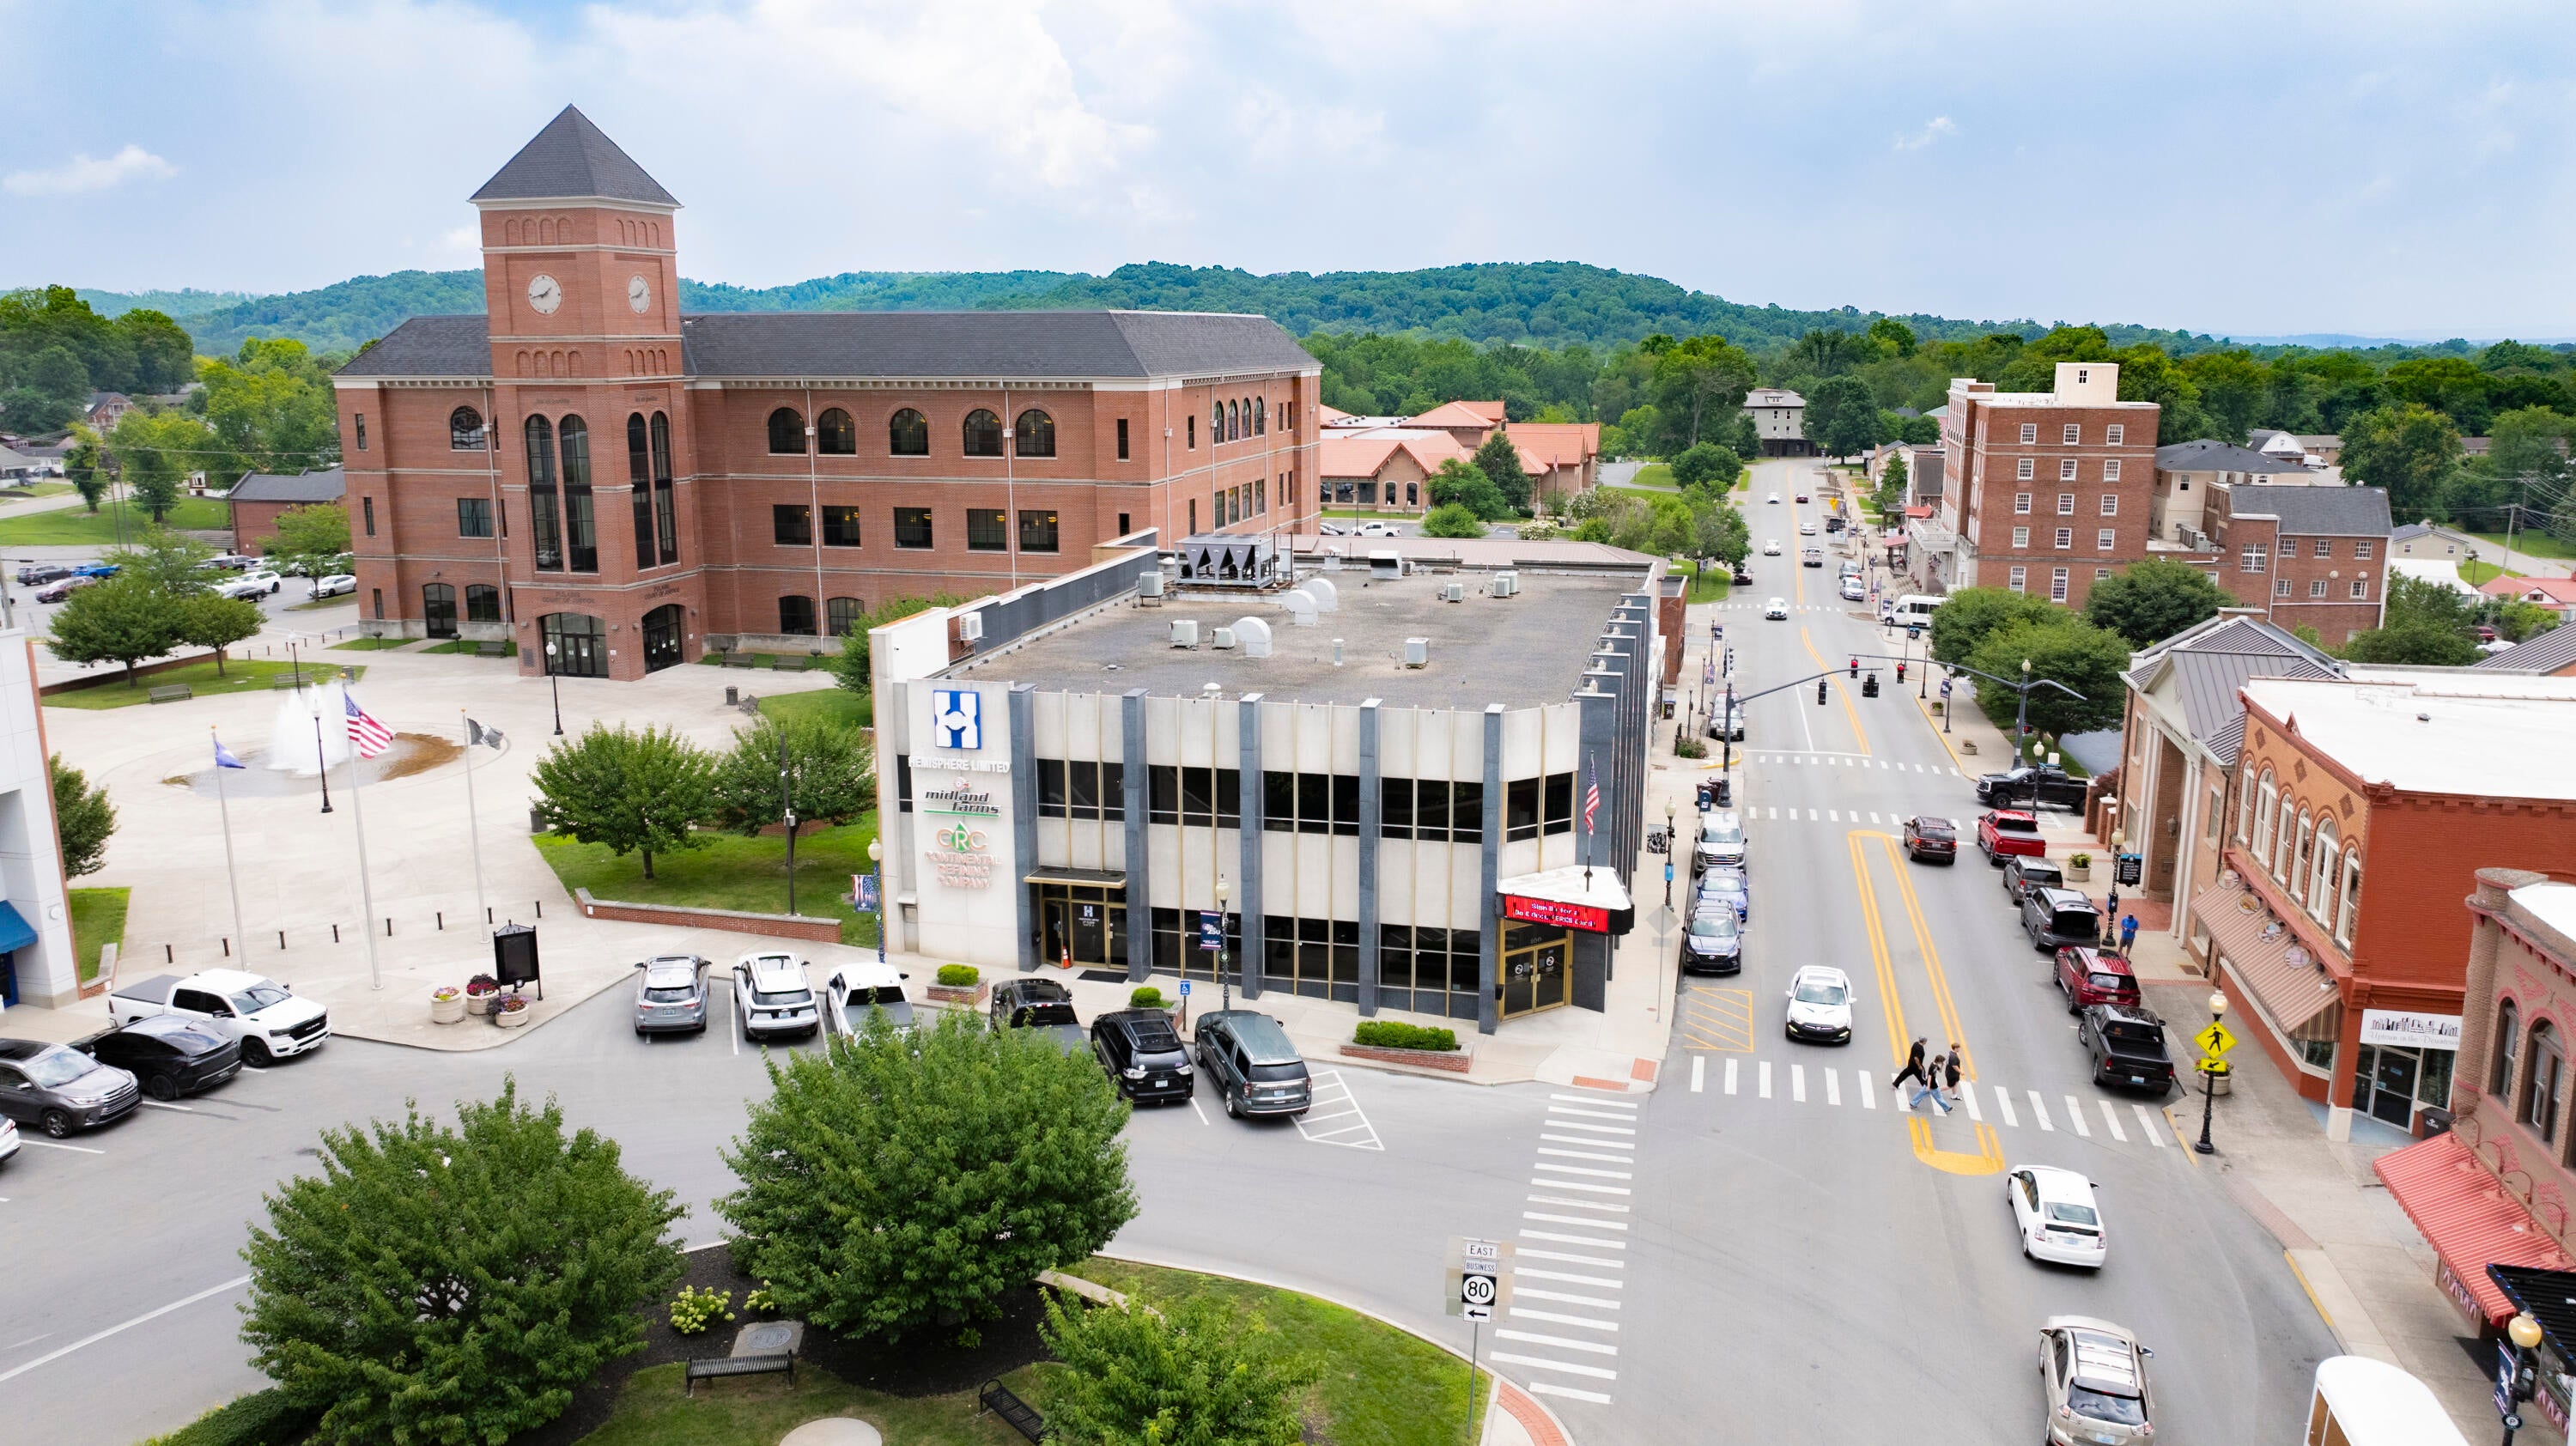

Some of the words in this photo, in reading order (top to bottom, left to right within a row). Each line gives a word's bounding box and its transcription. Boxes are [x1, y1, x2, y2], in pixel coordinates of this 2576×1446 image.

[908, 756, 969, 771] HEMISPHERE
[971, 760, 1011, 773] LIMITED
[925, 789, 989, 802] midland
[952, 800, 1000, 814] farms
[936, 827, 987, 852] CRC
[924, 850, 1002, 866] CONTINENTAL
[936, 864, 990, 878] REFINING
[936, 876, 991, 889] COMPANY
[2367, 1030, 2397, 1042] Uptown
[1470, 1245, 1494, 1256] EAST
[1466, 1262, 1495, 1272] BUSINESS
[1467, 1280, 1489, 1298] 80
